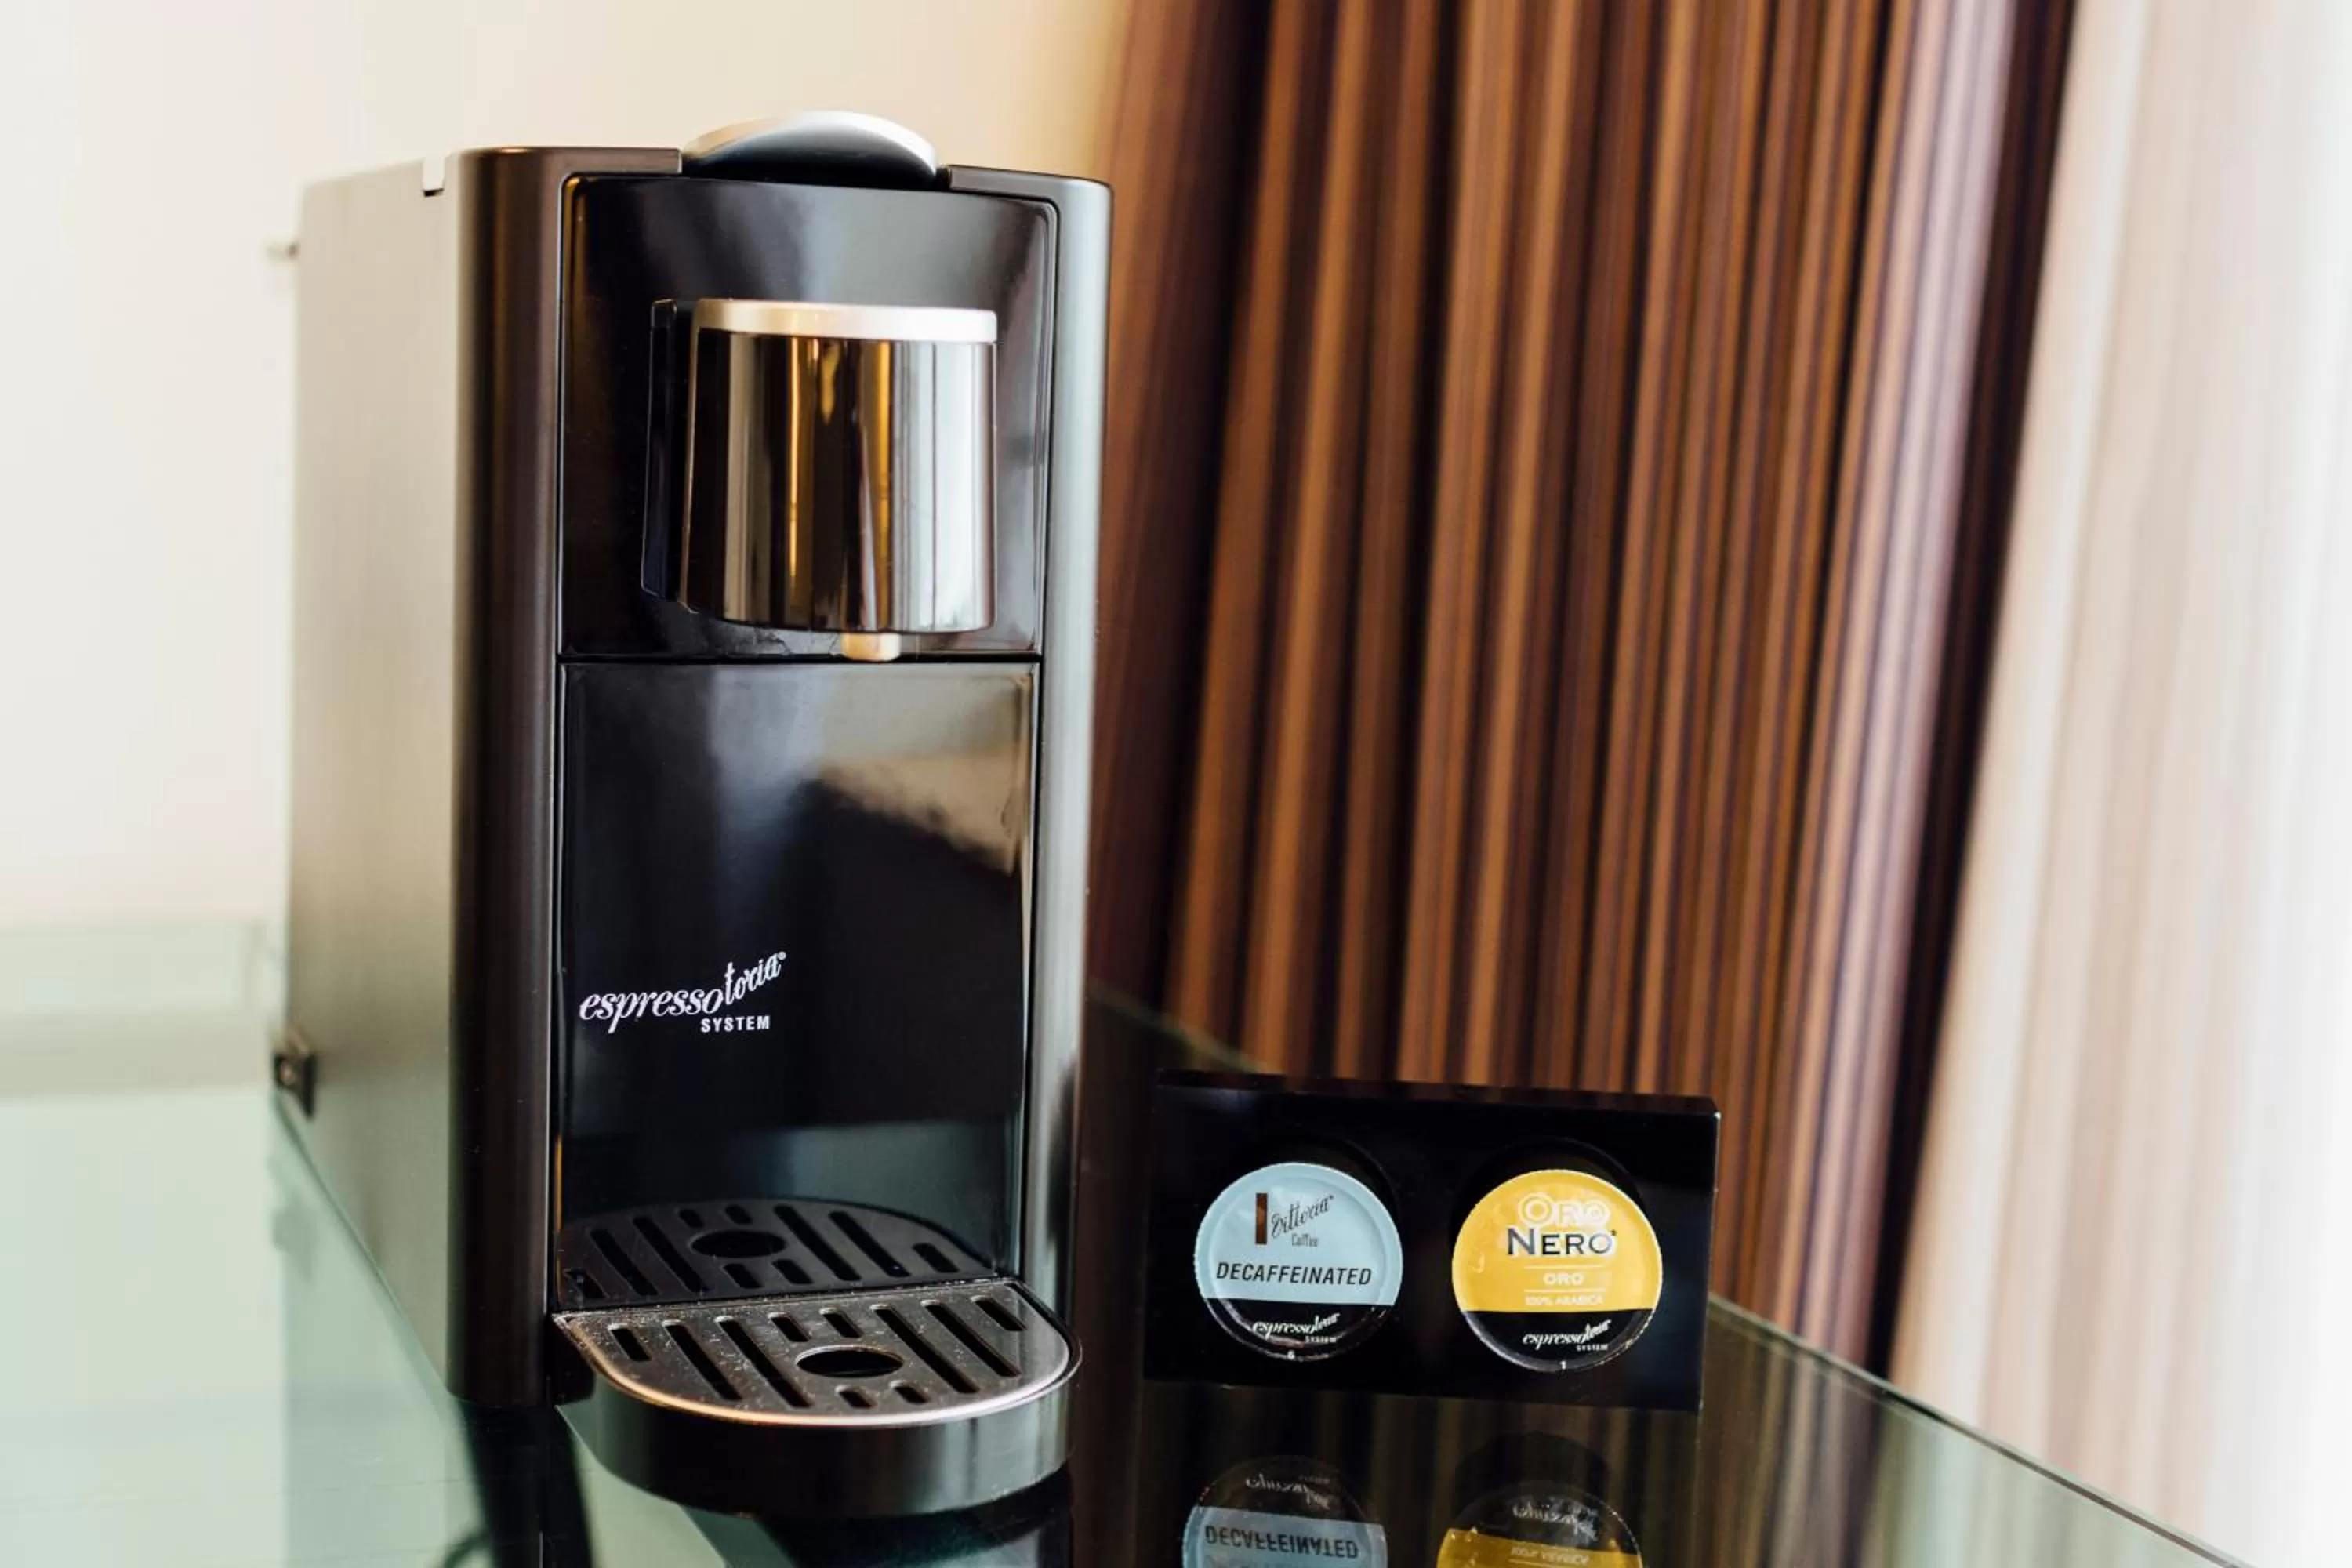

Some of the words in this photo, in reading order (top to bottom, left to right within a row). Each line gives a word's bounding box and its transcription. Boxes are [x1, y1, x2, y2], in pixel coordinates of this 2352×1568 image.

[579, 952, 784, 1034] espressotoria
[700, 1016, 770, 1033] SYSTEM
[1519, 1192, 1610, 1227] ORO
[1216, 1261, 1372, 1286] DECAFFEINATED
[1543, 1272, 1584, 1286] ORO
